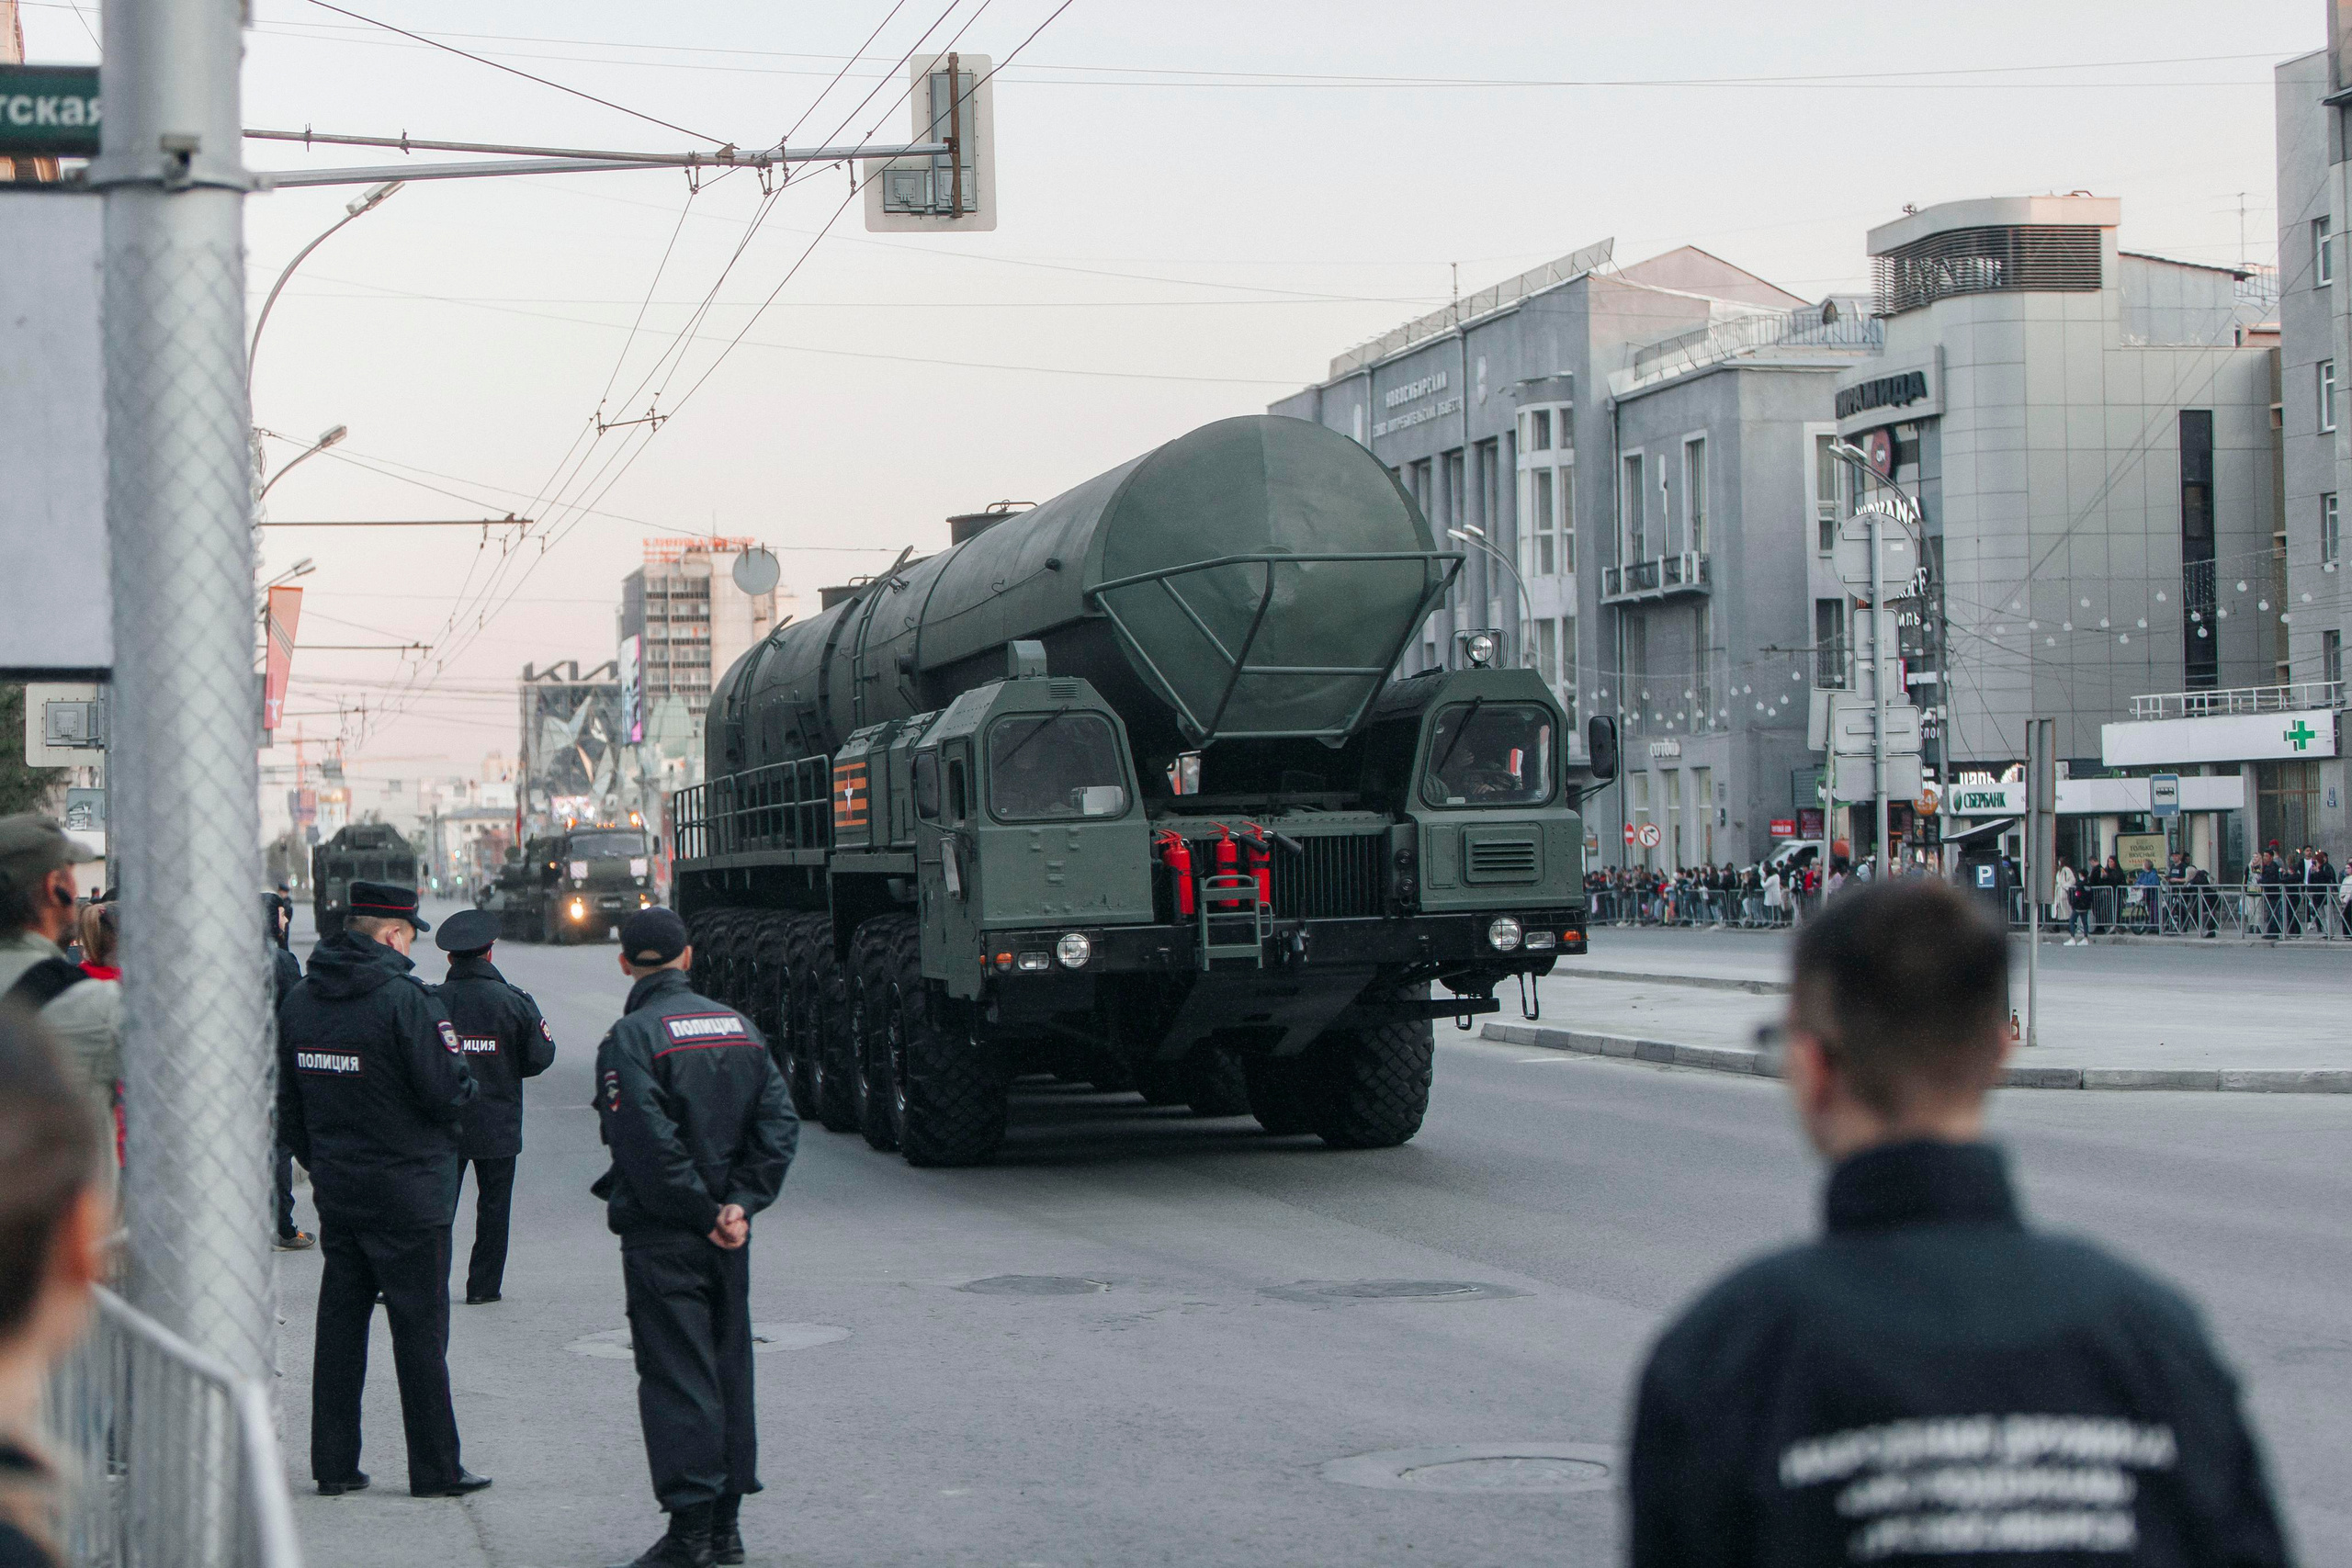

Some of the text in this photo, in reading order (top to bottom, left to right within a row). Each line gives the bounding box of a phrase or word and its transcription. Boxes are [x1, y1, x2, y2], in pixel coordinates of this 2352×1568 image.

[1836, 371, 1927, 419] ПИРАМИДА
[1963, 791, 2007, 808] СБЕРБАНК
[669, 1018, 743, 1037] ПОЛИЦИЯ
[463, 1039, 496, 1053] ИЦИЯ
[298, 1053, 359, 1073] ПОЛИЦИЯ
